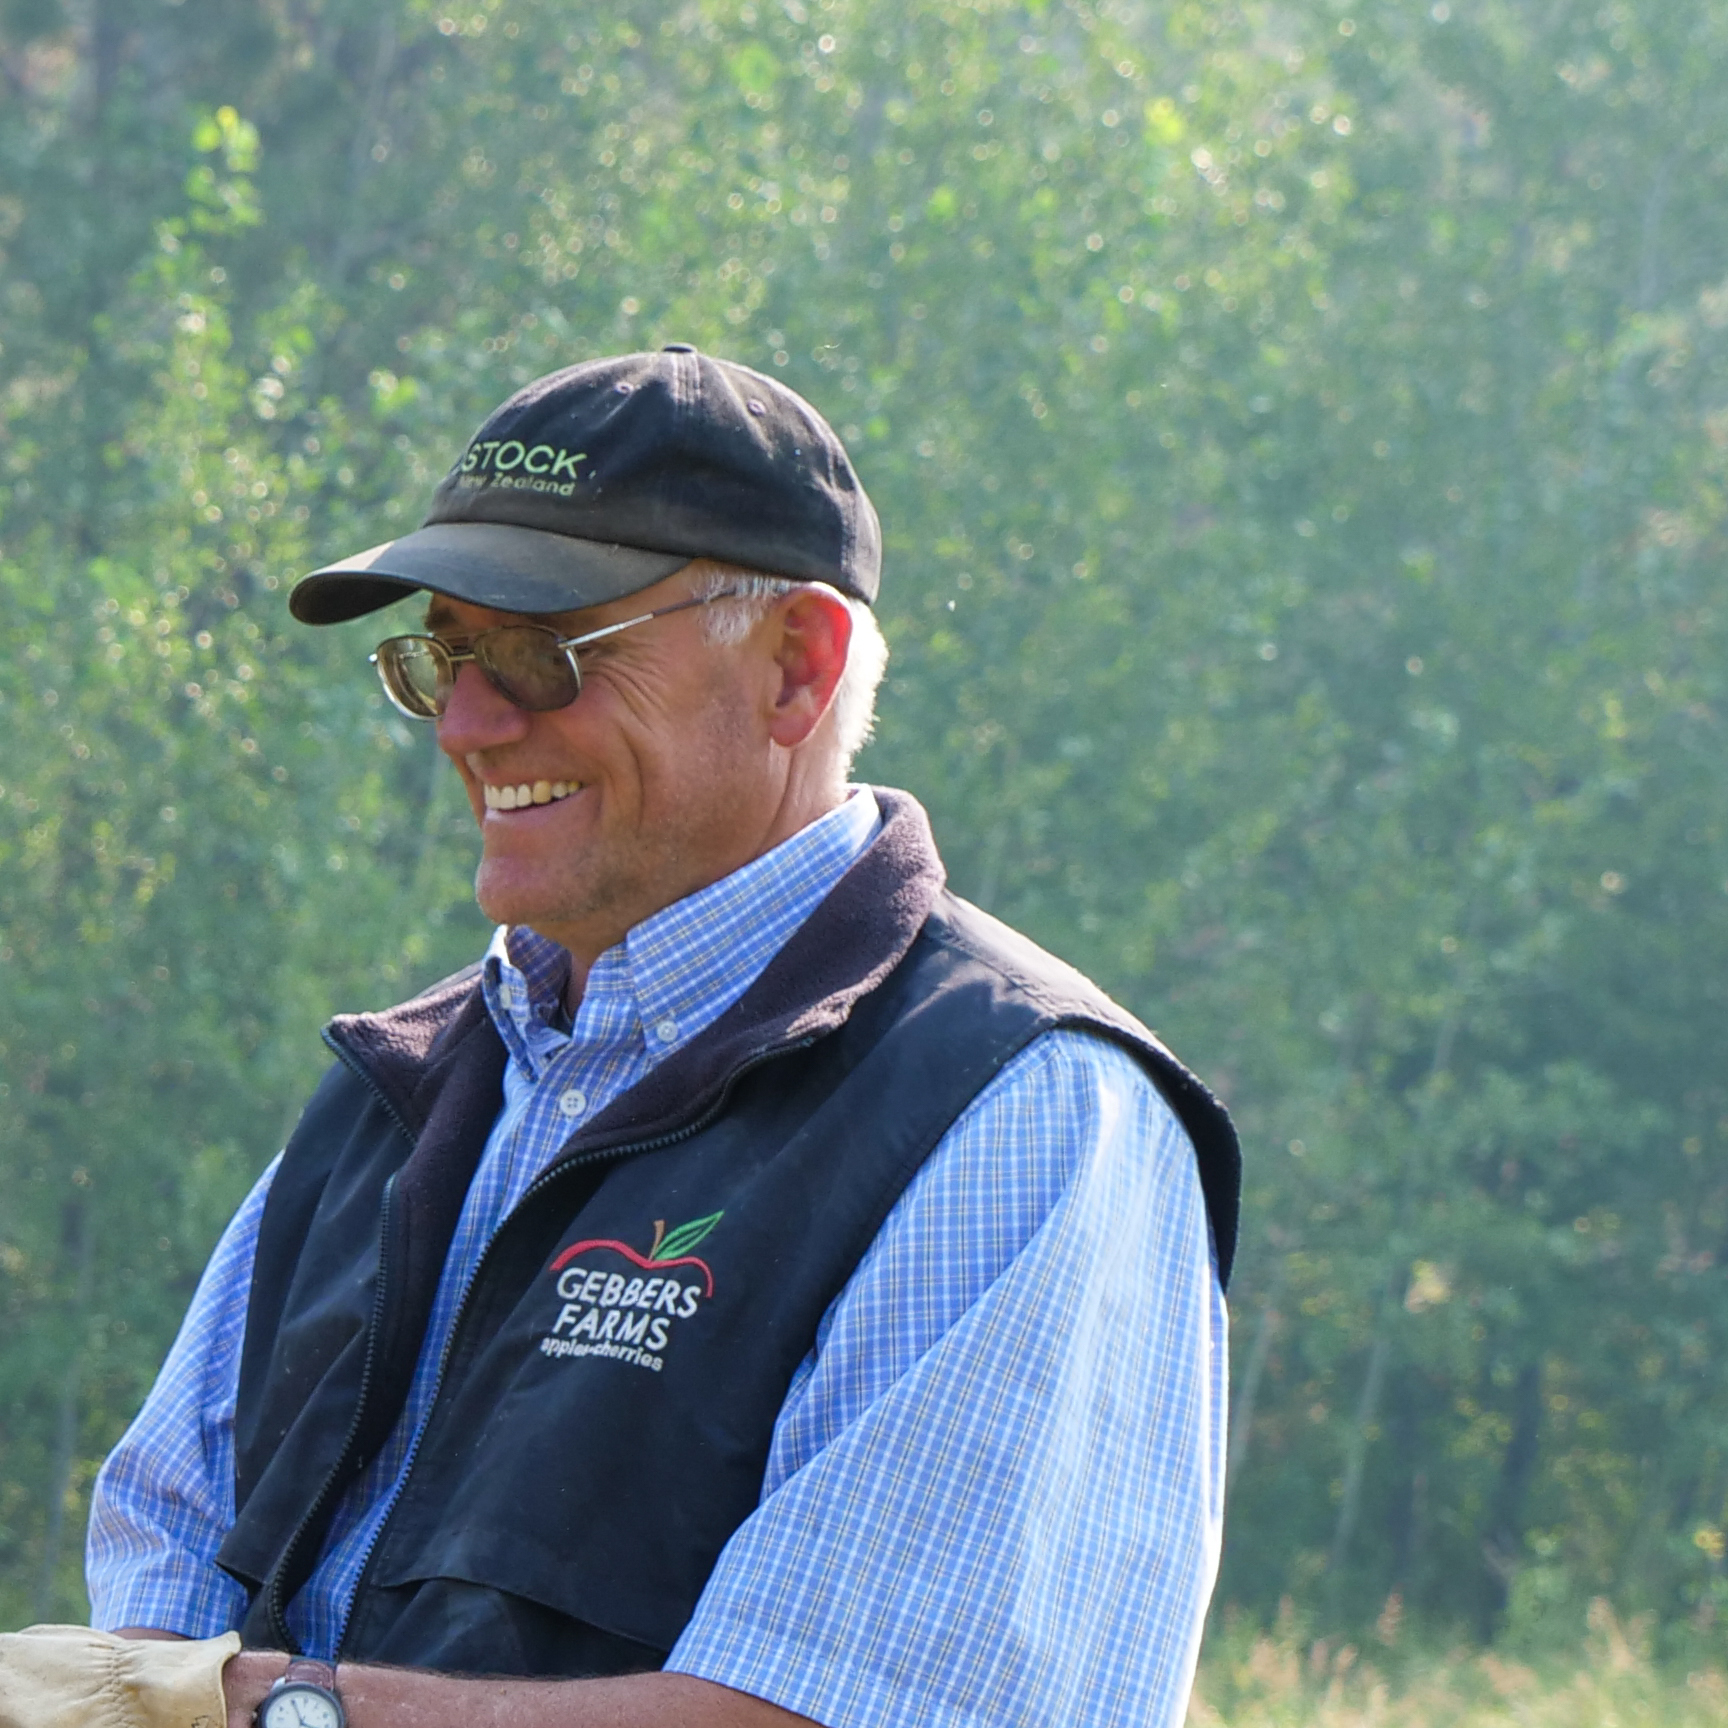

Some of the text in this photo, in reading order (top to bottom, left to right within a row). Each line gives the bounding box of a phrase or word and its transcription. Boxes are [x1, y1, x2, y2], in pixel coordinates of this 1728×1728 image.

[461, 440, 588, 479] STOCK
[490, 472, 577, 497] Zealand
[556, 1266, 702, 1319] GEBBERS
[551, 1303, 670, 1351] FARMS
